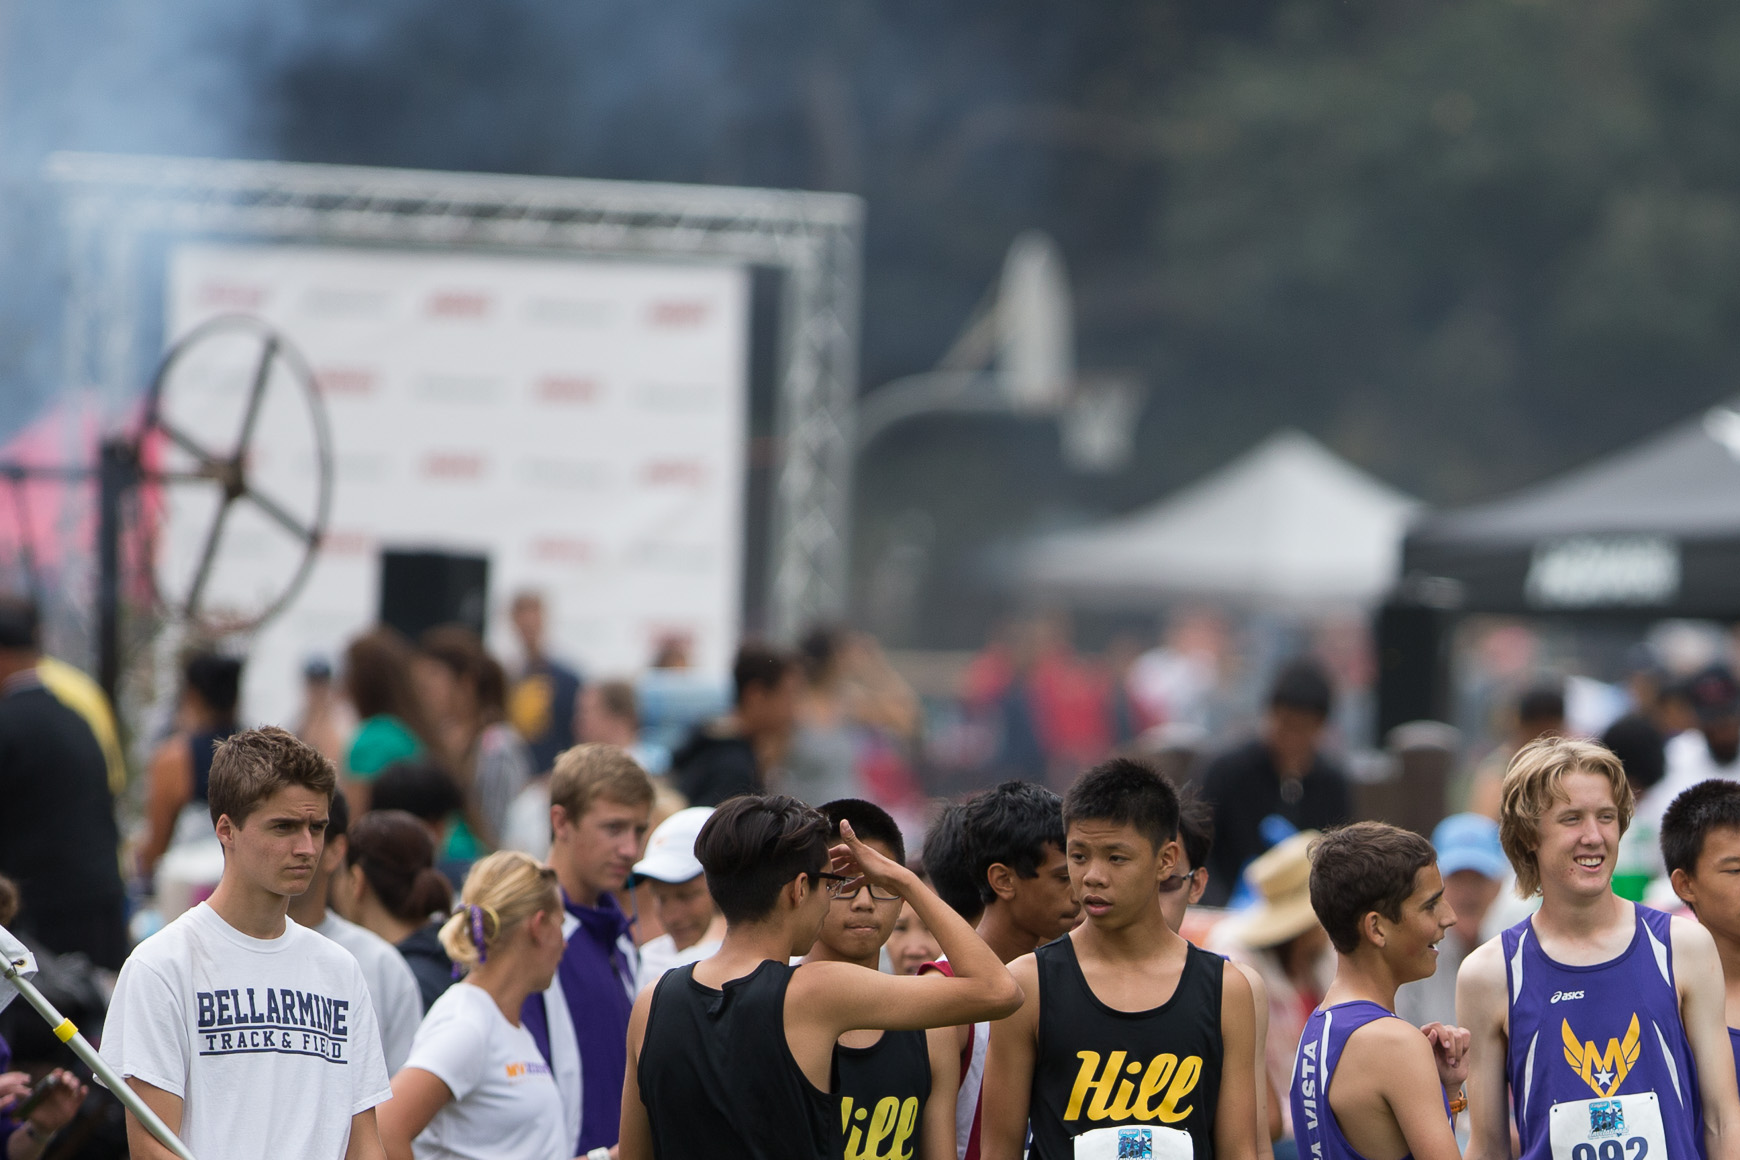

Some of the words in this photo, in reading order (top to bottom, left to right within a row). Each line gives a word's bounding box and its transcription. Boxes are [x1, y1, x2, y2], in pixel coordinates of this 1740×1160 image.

[197, 988, 349, 1036] BELLARMINE
[206, 1031, 275, 1051] TRACK
[281, 1032, 292, 1049] &
[1063, 1050, 1204, 1123] Hill
[1301, 1039, 1319, 1131] VISTA
